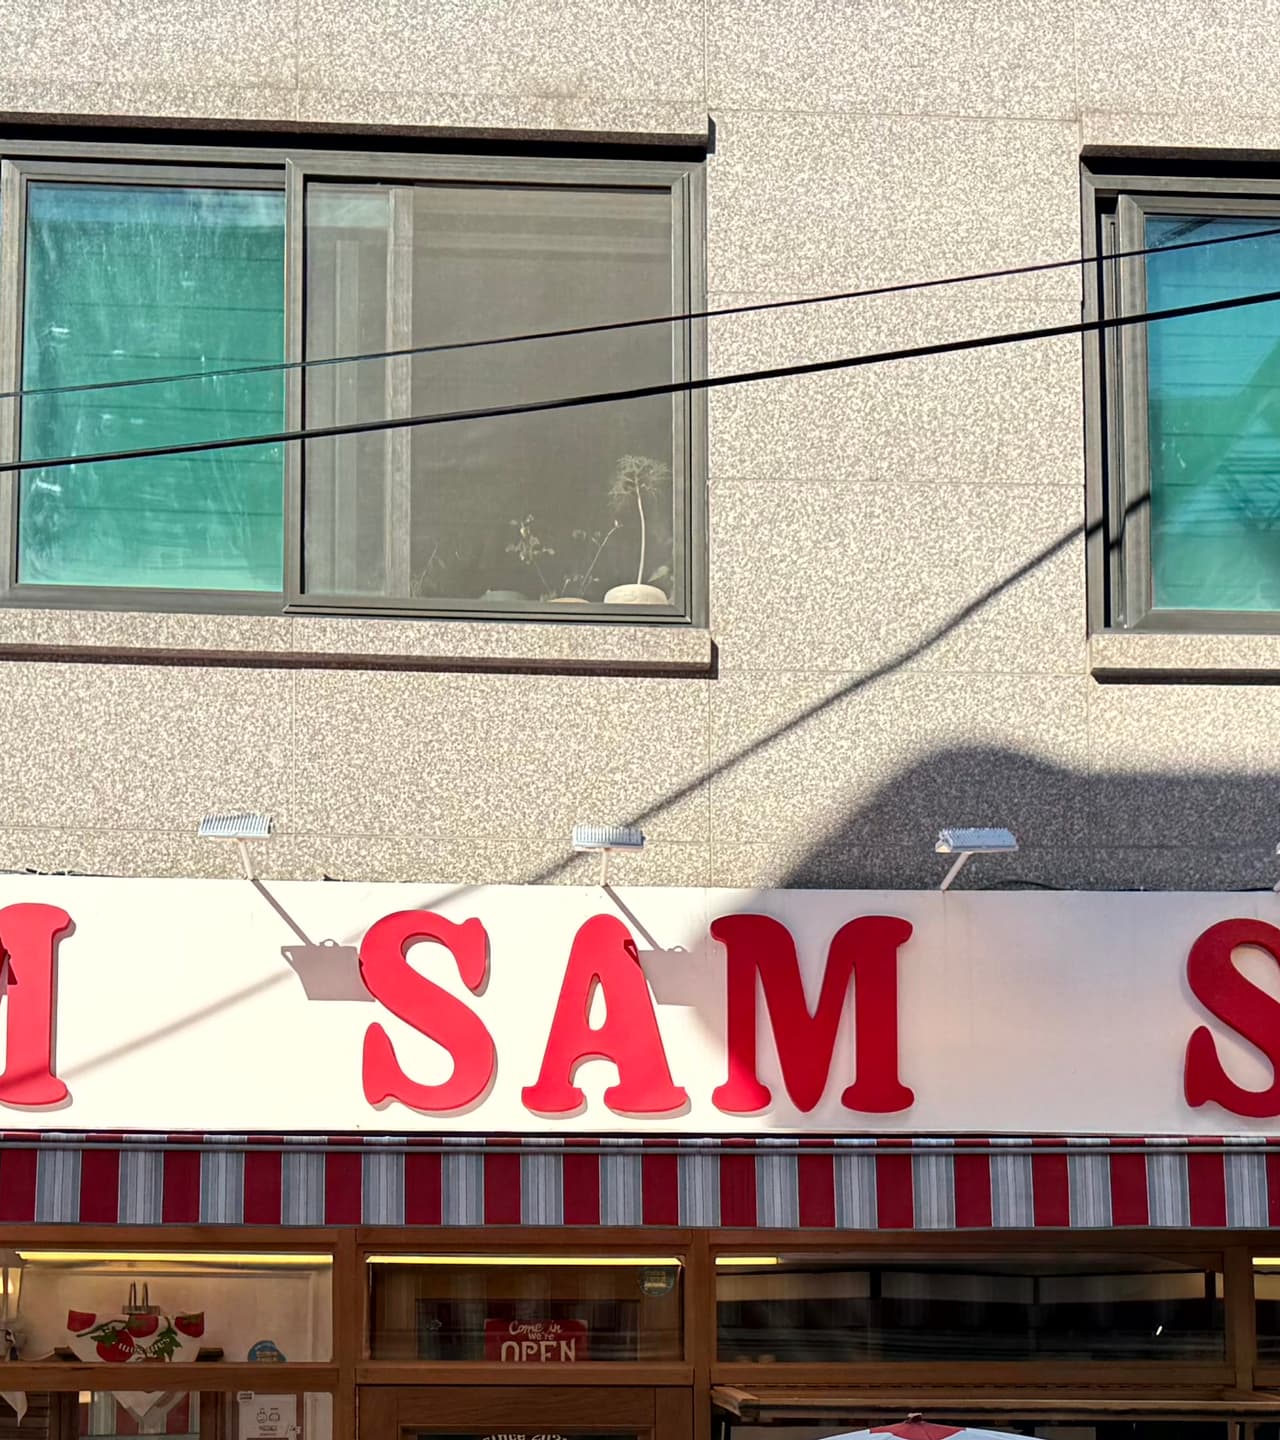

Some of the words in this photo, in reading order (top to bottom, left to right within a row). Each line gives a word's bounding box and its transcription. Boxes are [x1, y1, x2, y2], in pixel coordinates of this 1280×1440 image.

[358, 906, 915, 1116] SAM
[508, 1320, 545, 1335] Come
[501, 1338, 576, 1362] OPEN
